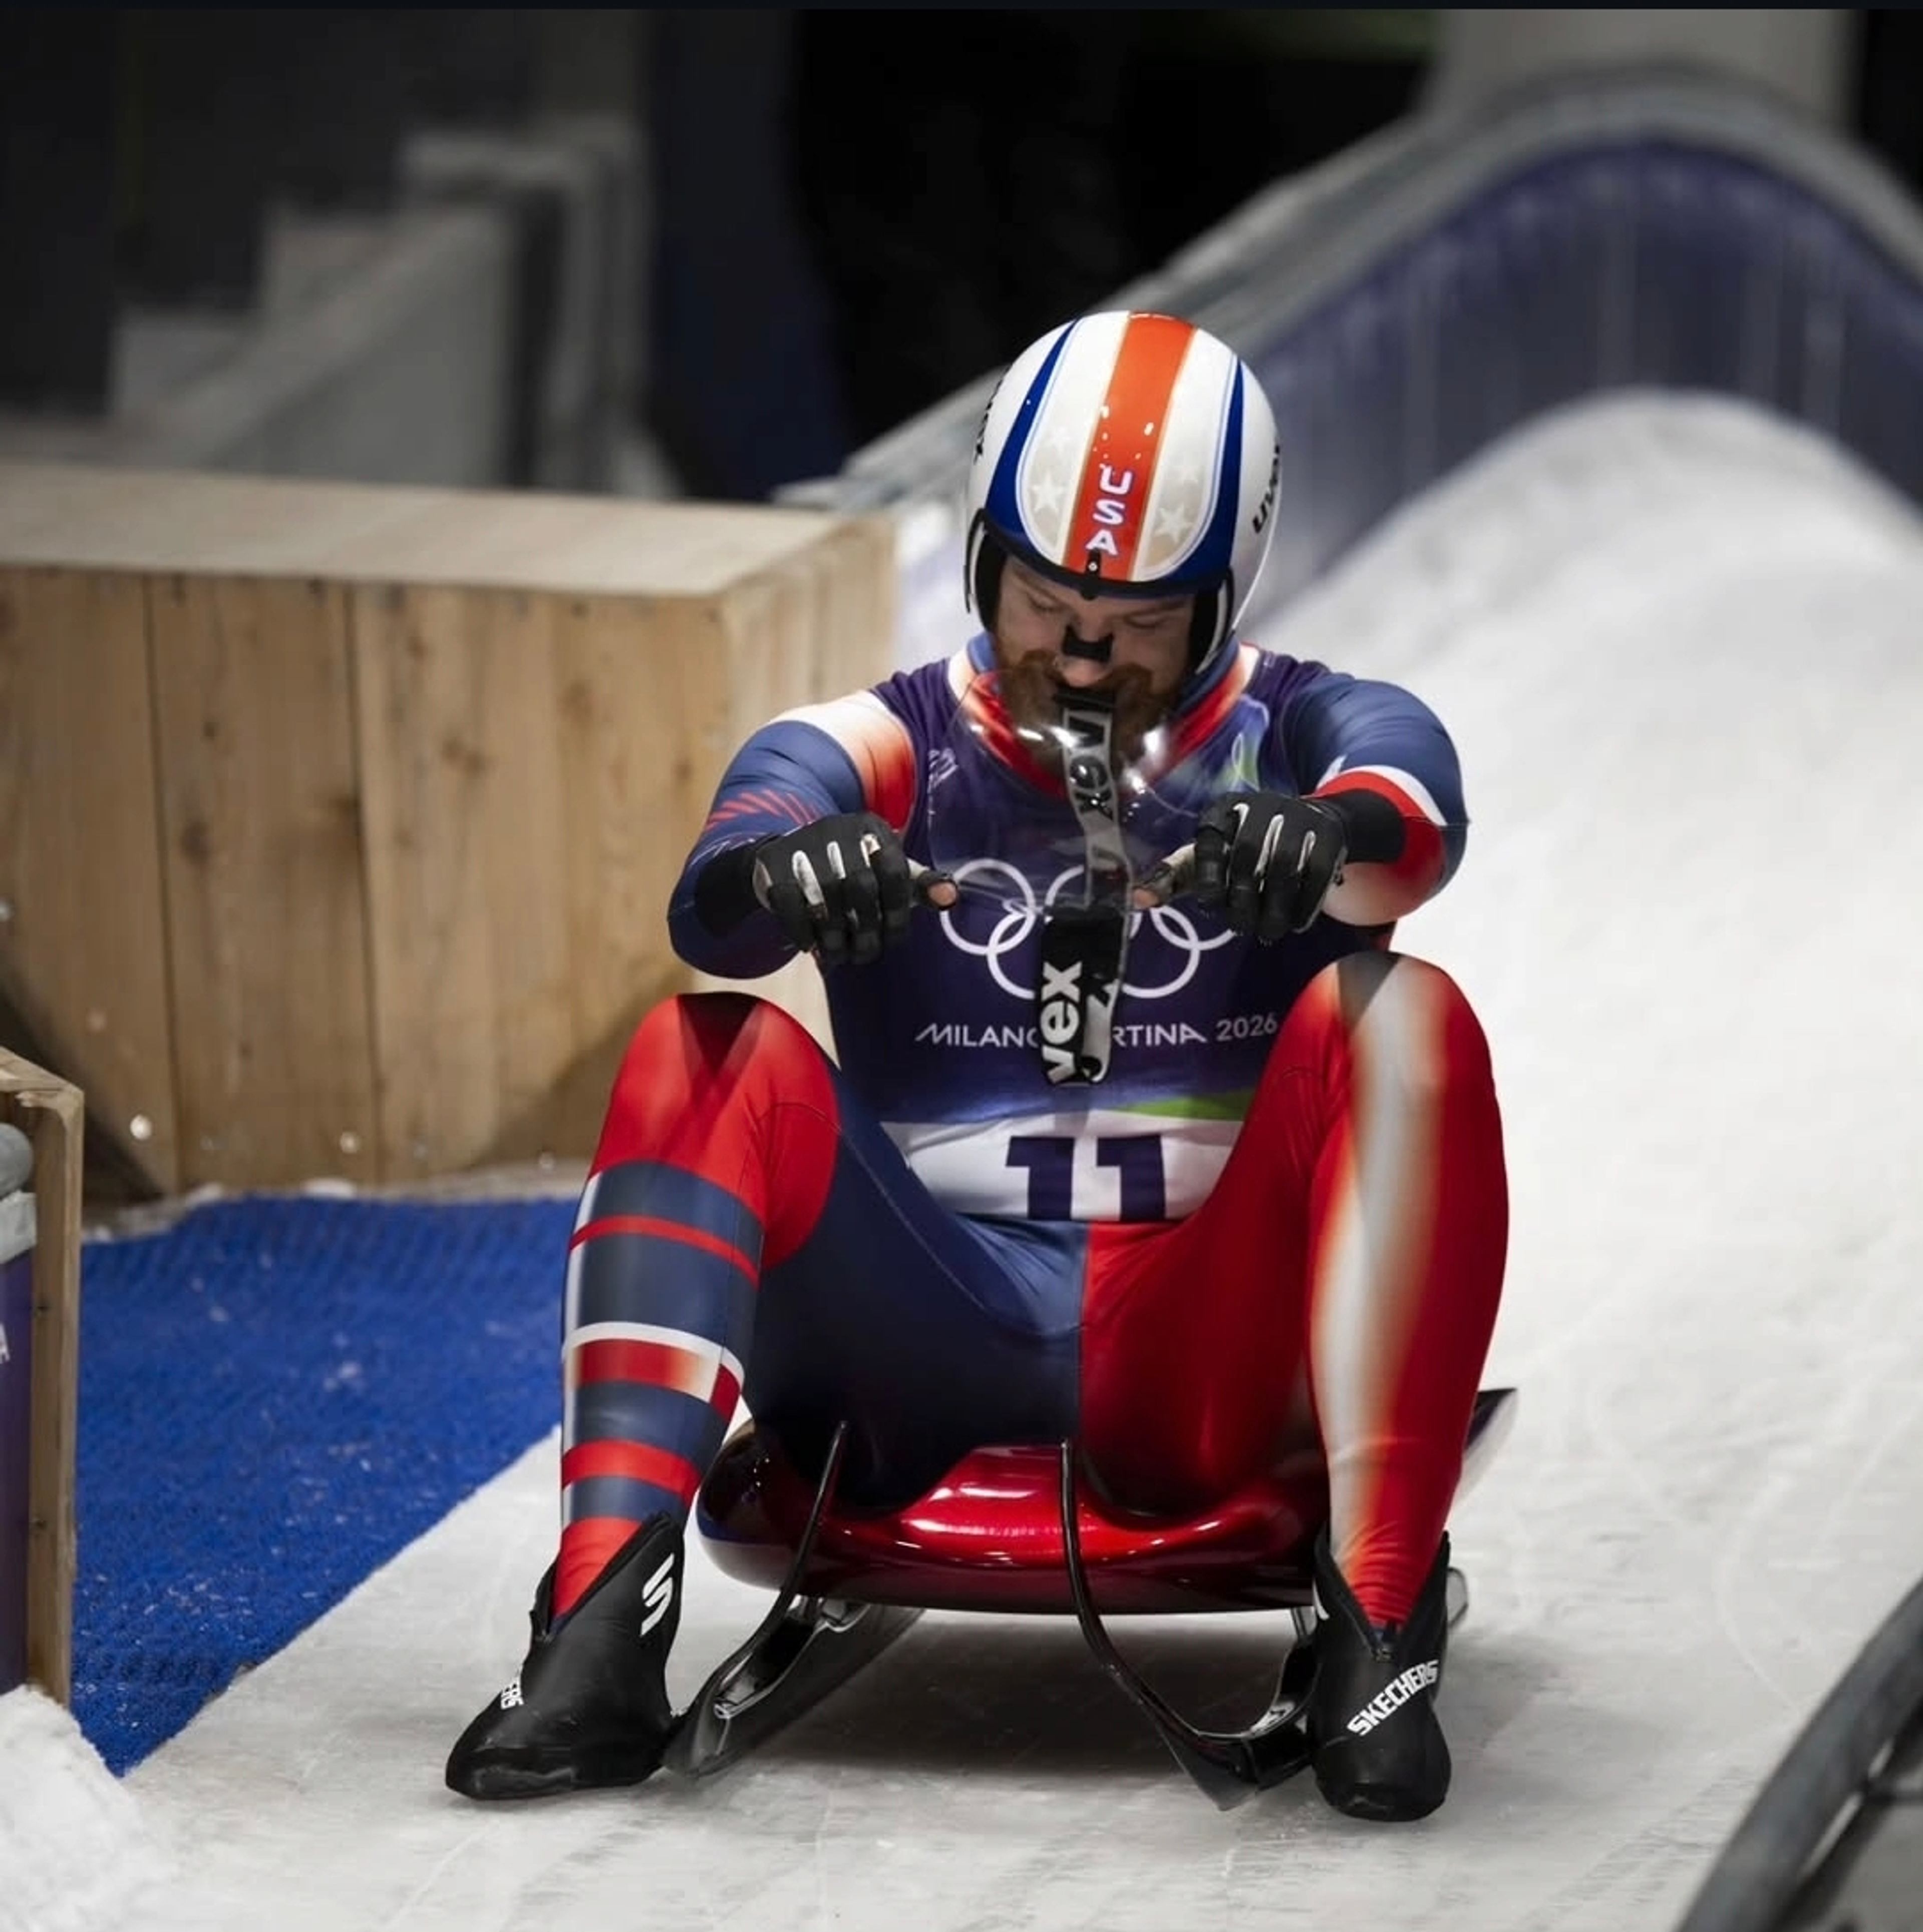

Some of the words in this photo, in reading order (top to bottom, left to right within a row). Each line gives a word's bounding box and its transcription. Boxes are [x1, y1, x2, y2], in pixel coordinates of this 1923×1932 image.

[1086, 466, 1132, 556] USA
[1112, 1023, 1206, 1047] RTINA
[1216, 1013, 1278, 1041] 2026
[1006, 1135, 1167, 1221] 11
[1347, 1659, 1439, 1736] SKECHERS
